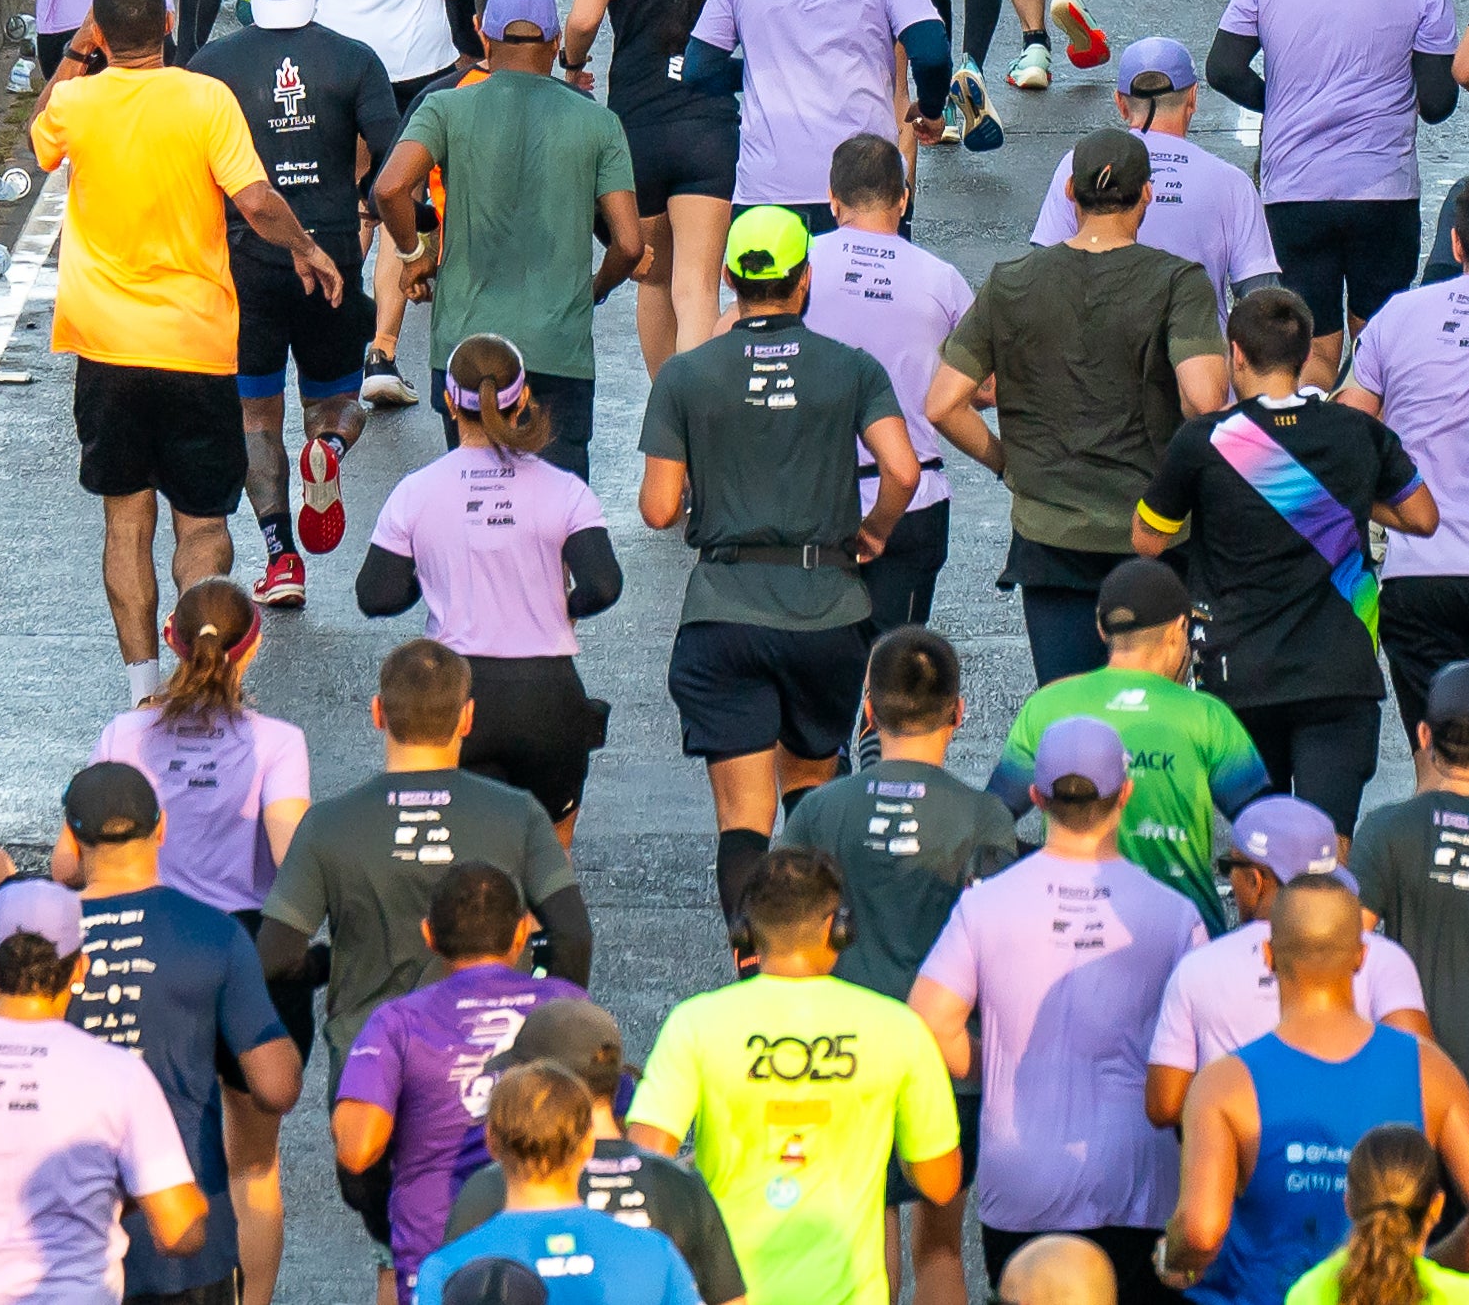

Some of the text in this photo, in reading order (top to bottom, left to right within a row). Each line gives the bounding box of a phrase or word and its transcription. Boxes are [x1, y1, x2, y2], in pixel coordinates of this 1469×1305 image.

[268, 115, 317, 129] TOP TEAM
[1172, 154, 1190, 165] 25
[1164, 180, 1184, 189] rvb
[880, 247, 897, 260] 25
[872, 274, 892, 286] rvb
[781, 342, 801, 356] 25
[498, 467, 517, 479] 25
[745, 1034, 858, 1081] 2025
